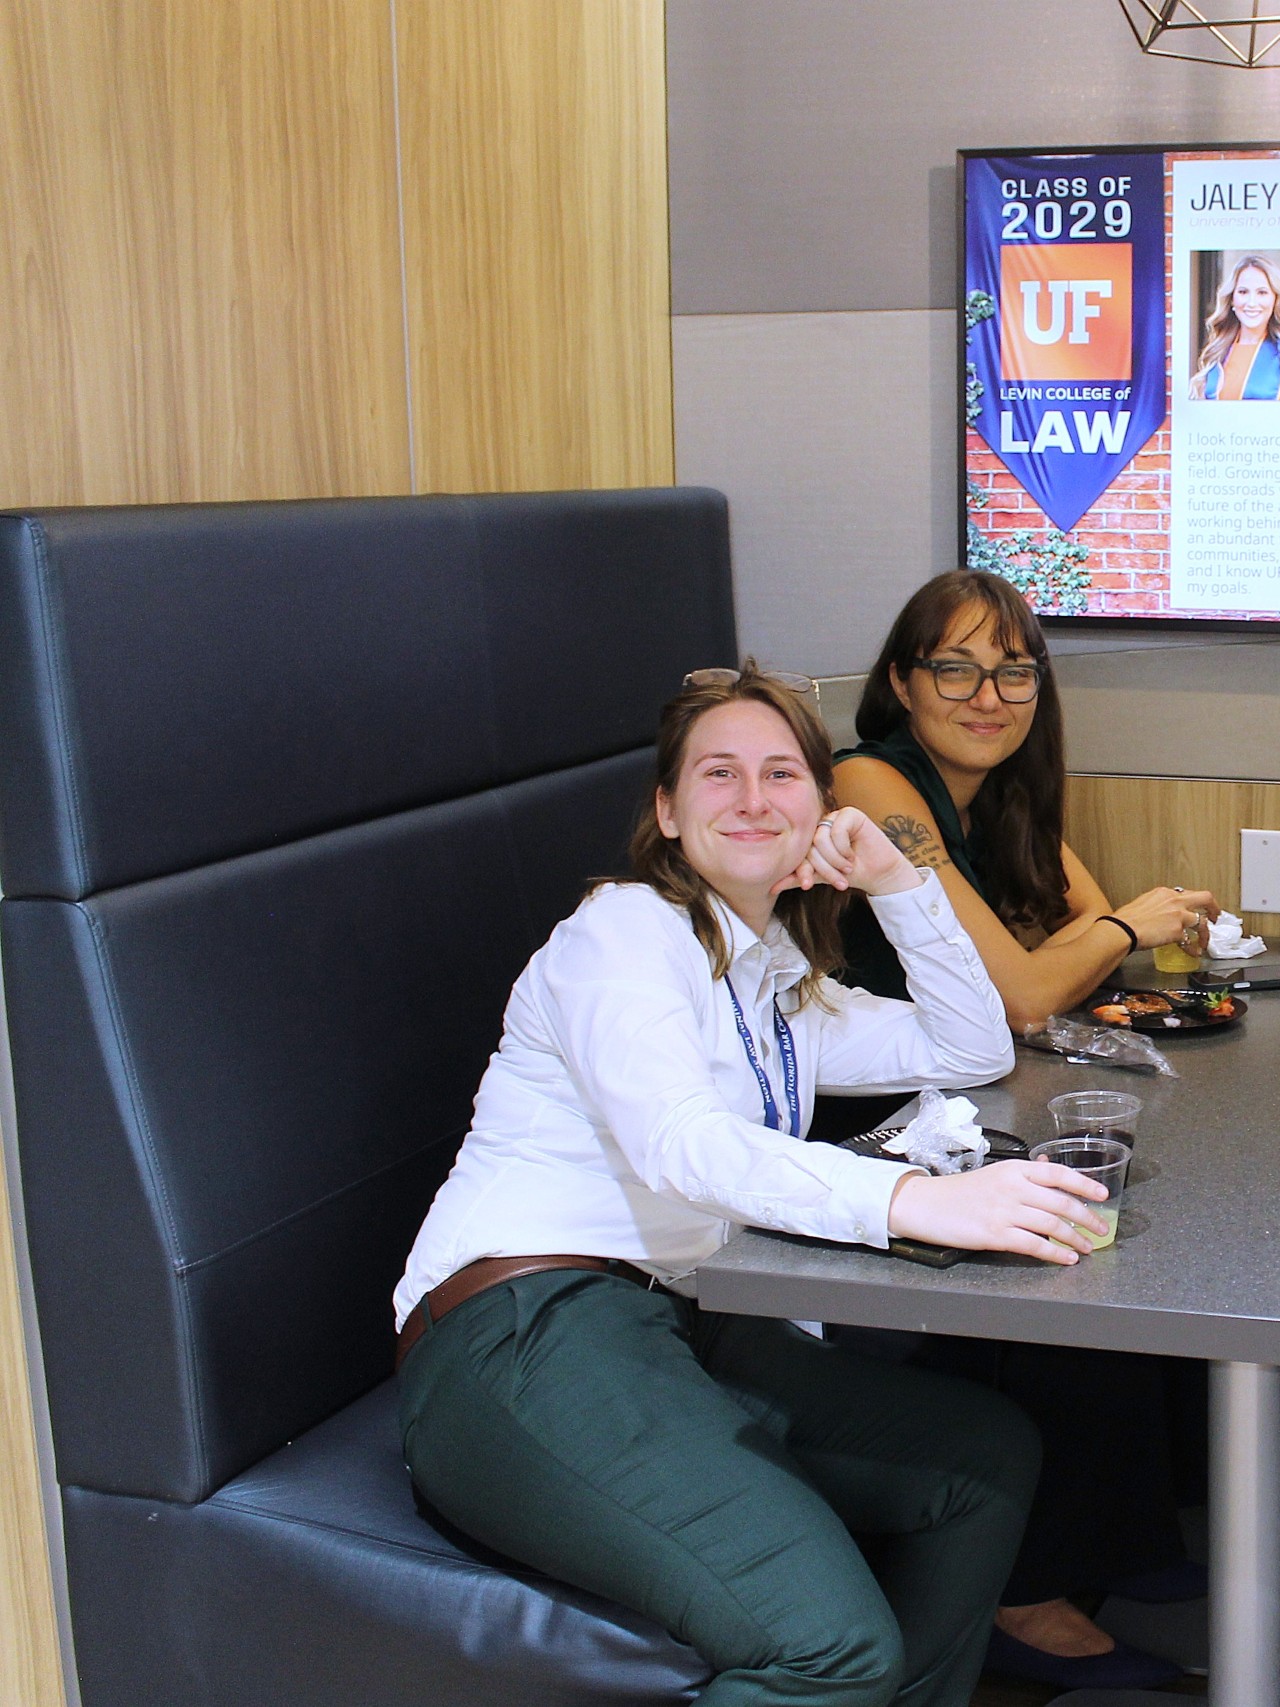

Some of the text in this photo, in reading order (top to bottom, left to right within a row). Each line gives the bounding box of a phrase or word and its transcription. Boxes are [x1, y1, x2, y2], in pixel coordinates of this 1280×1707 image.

[1001, 176, 1132, 198] CLASS OF
[1190, 183, 1280, 212] JALEY
[1001, 200, 1132, 240] 2029
[1021, 279, 1112, 344] UF
[1000, 386, 1131, 401] LEVIN COLLEGE of
[1000, 411, 1131, 454] LAW
[1197, 432, 1225, 445] look
[1188, 449, 1252, 466] exploring
[1257, 450, 1279, 463] the
[1188, 465, 1219, 478] field.
[1199, 482, 1275, 496] crossroads
[1187, 498, 1228, 511] future
[1233, 499, 1247, 512] of
[1251, 499, 1273, 512] the
[1186, 514, 1241, 532] working
[1187, 534, 1203, 544] an
[1208, 531, 1274, 545] abundant
[1187, 548, 1278, 564] communities,
[1186, 564, 1212, 577] and
[1226, 564, 1262, 578] know
[1187, 580, 1250, 597] my goals.
[744, 1036, 756, 1058] LAW
[782, 1032, 791, 1052] BAR
[787, 1052, 796, 1092] FLORIDA
